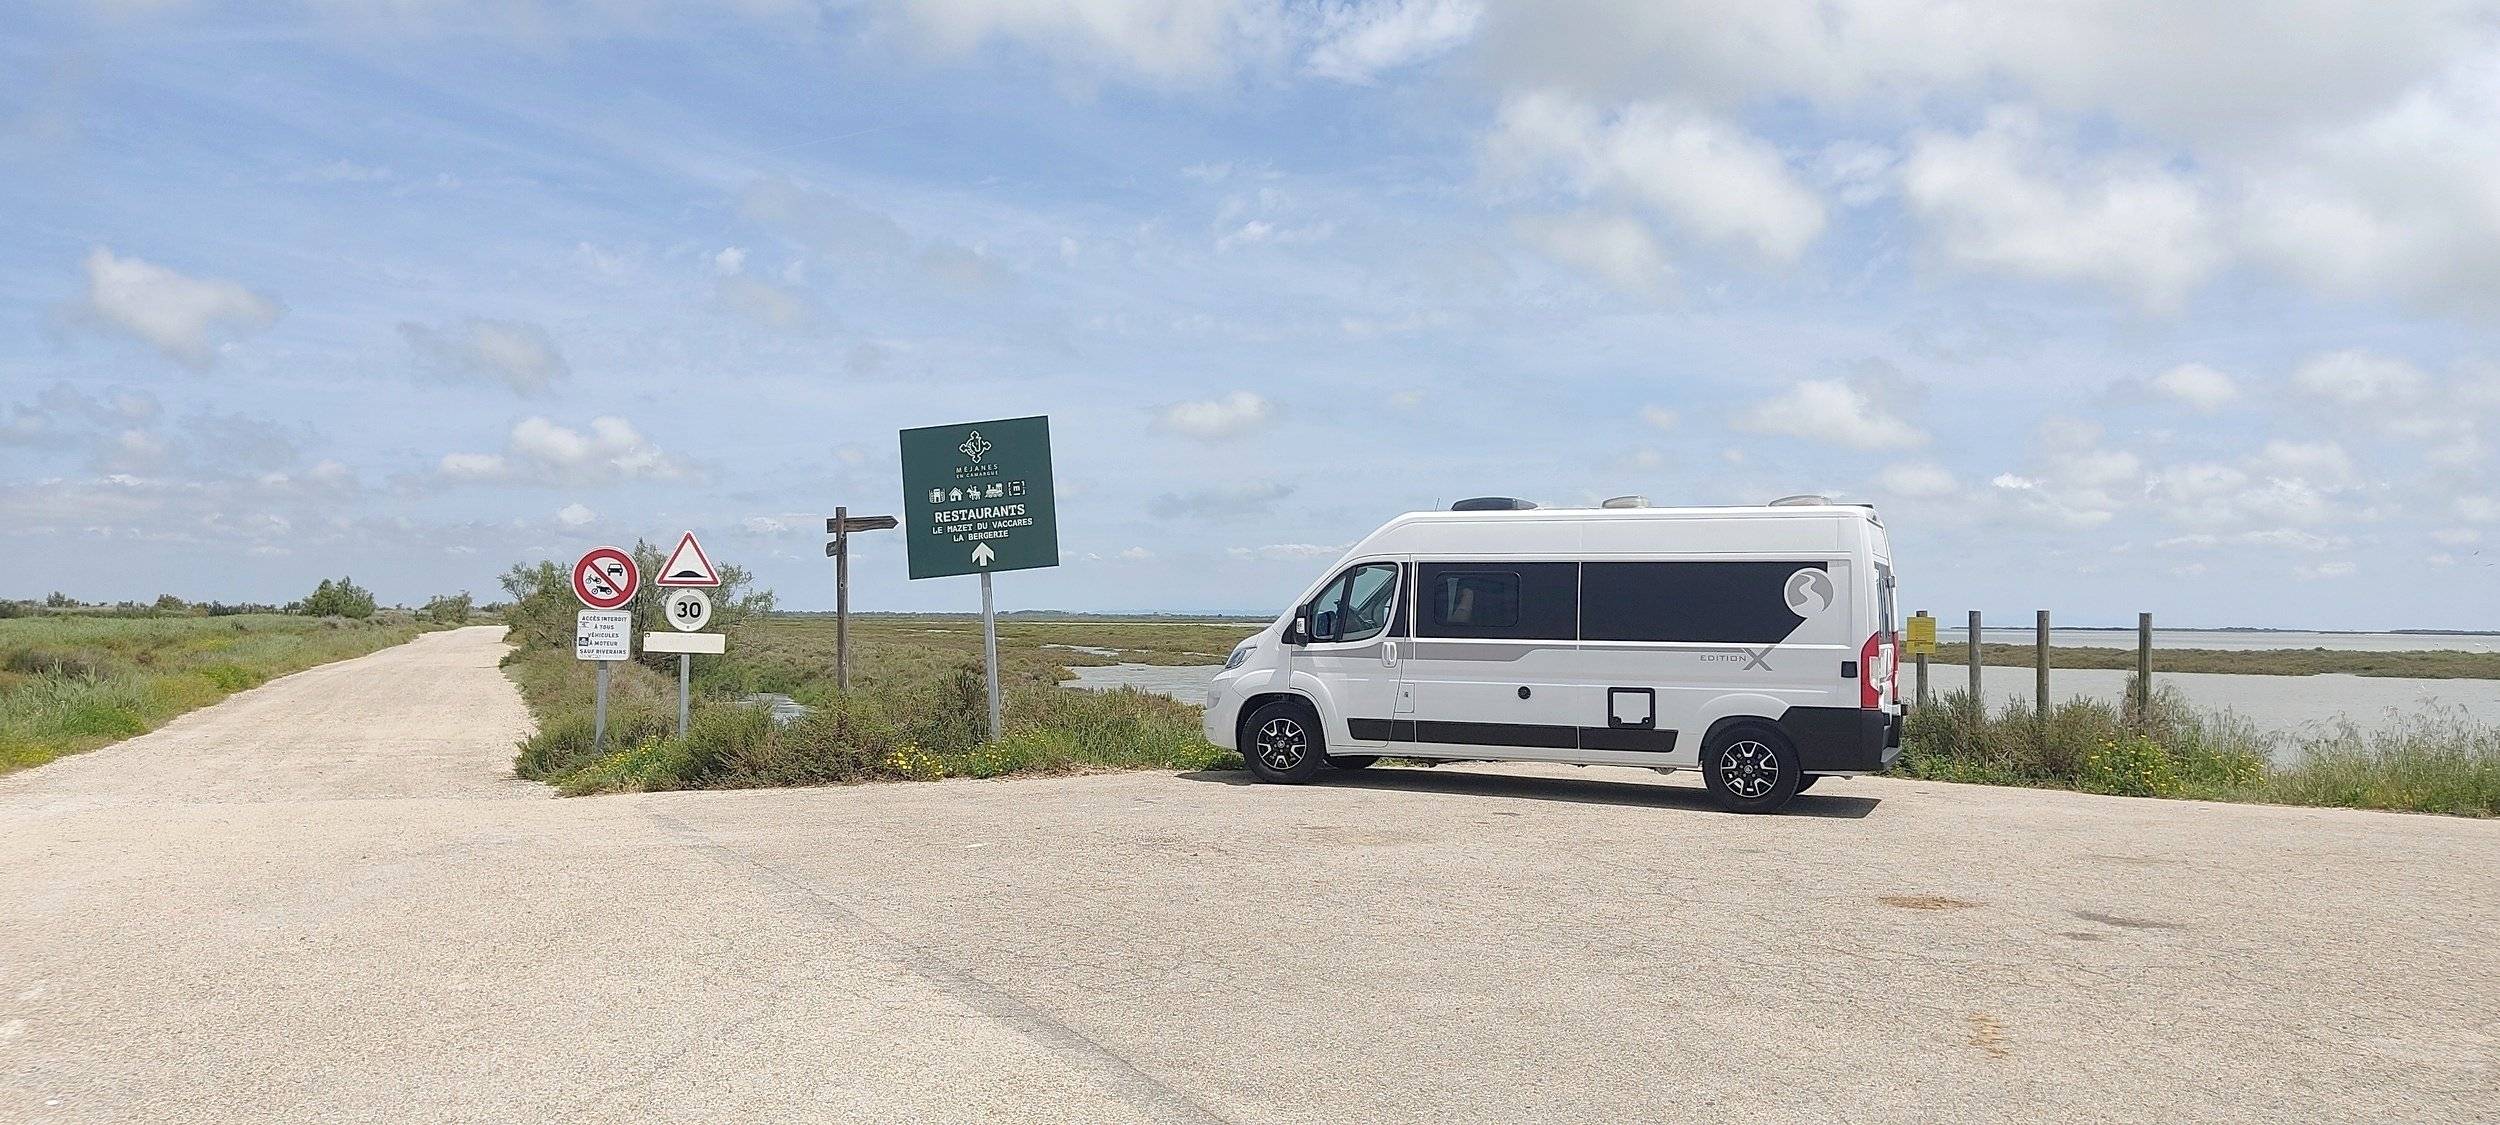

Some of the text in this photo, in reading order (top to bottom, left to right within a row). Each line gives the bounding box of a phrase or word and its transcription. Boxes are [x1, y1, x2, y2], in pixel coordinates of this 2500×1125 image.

[934, 504, 1026, 523] RESTAURANTS
[932, 517, 1033, 535] LE MAZET DU VACCARES
[953, 529, 1009, 542] LA BERGERIE
[676, 601, 702, 619] 30
[1700, 645, 1777, 672] EDITION X
